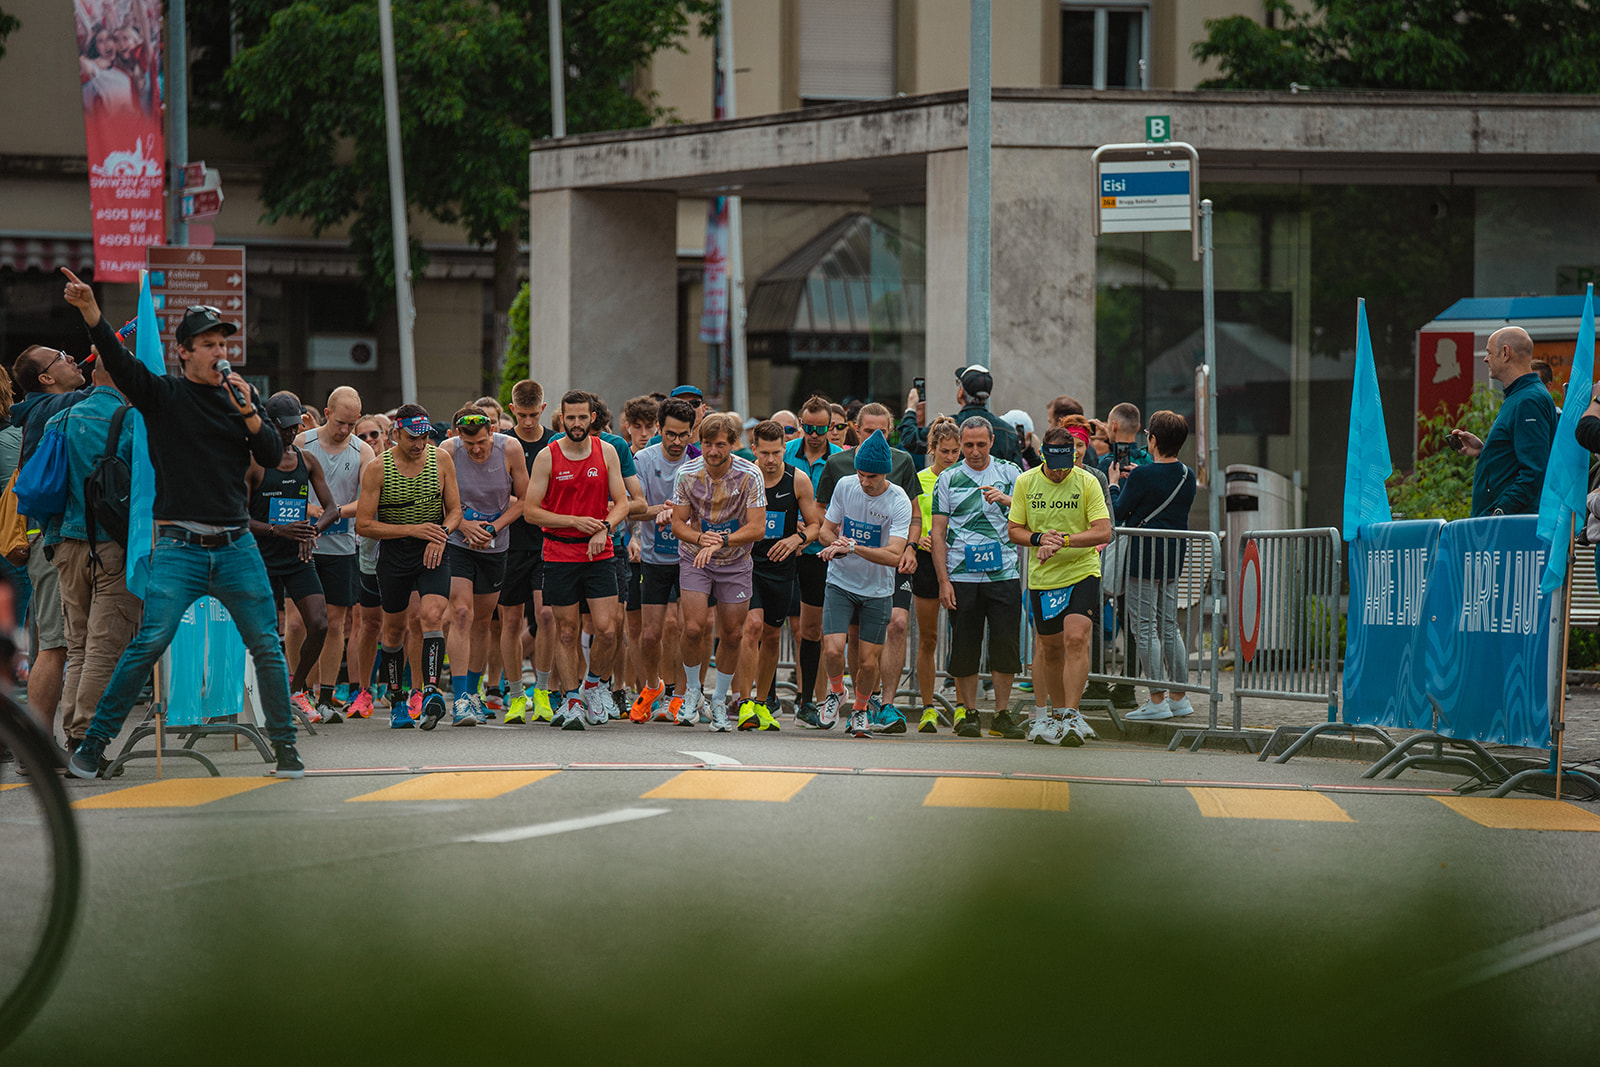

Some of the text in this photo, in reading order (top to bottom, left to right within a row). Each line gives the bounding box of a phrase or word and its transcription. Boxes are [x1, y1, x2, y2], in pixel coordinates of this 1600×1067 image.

[1150, 118, 1166, 139] B
[1103, 179, 1126, 192] Eisi
[1031, 501, 1078, 509] SIR JOHN
[279, 507, 301, 518] 222
[850, 528, 871, 540] 156
[974, 551, 995, 563] 241
[1397, 548, 1428, 626] LAUF
[1501, 551, 1545, 635] LAUF
